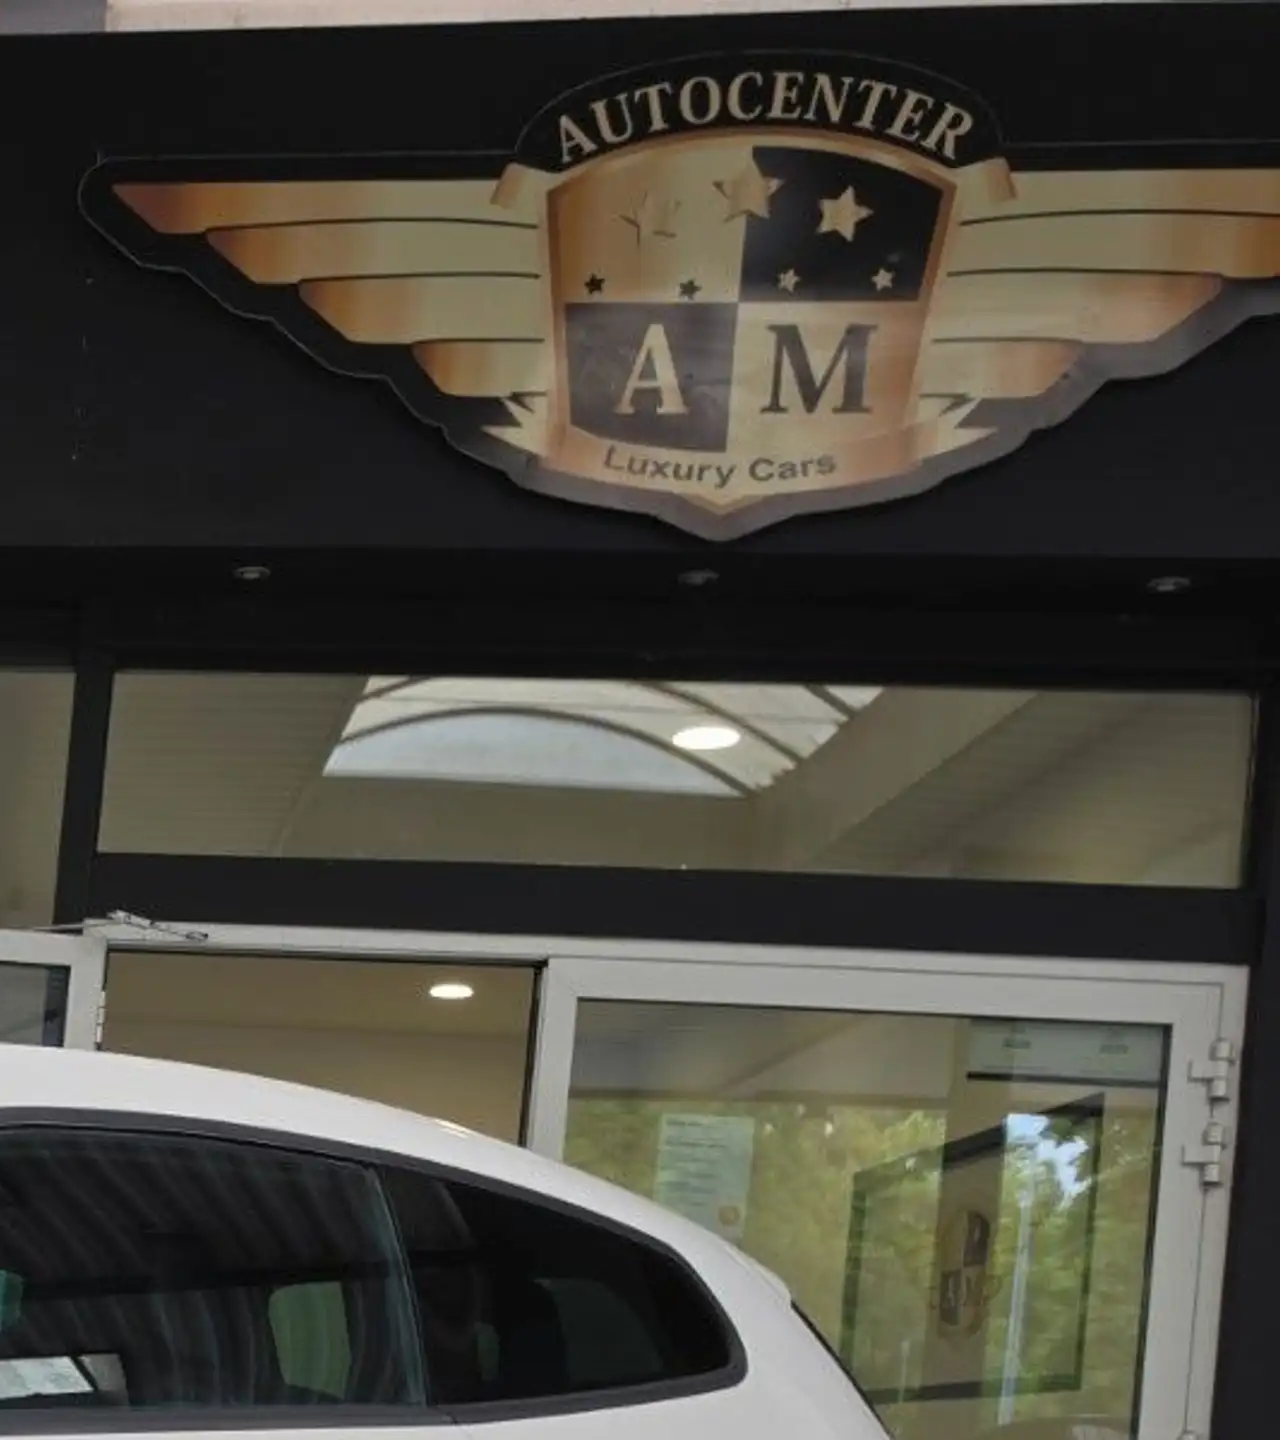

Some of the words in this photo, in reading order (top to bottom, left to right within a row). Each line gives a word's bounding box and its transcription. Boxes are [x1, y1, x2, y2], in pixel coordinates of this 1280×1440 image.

[558, 70, 975, 163] AUTOCENTER
[613, 322, 689, 415] A
[759, 322, 879, 415] M
[603, 444, 740, 489] Luxury
[747, 454, 839, 482] Cars
